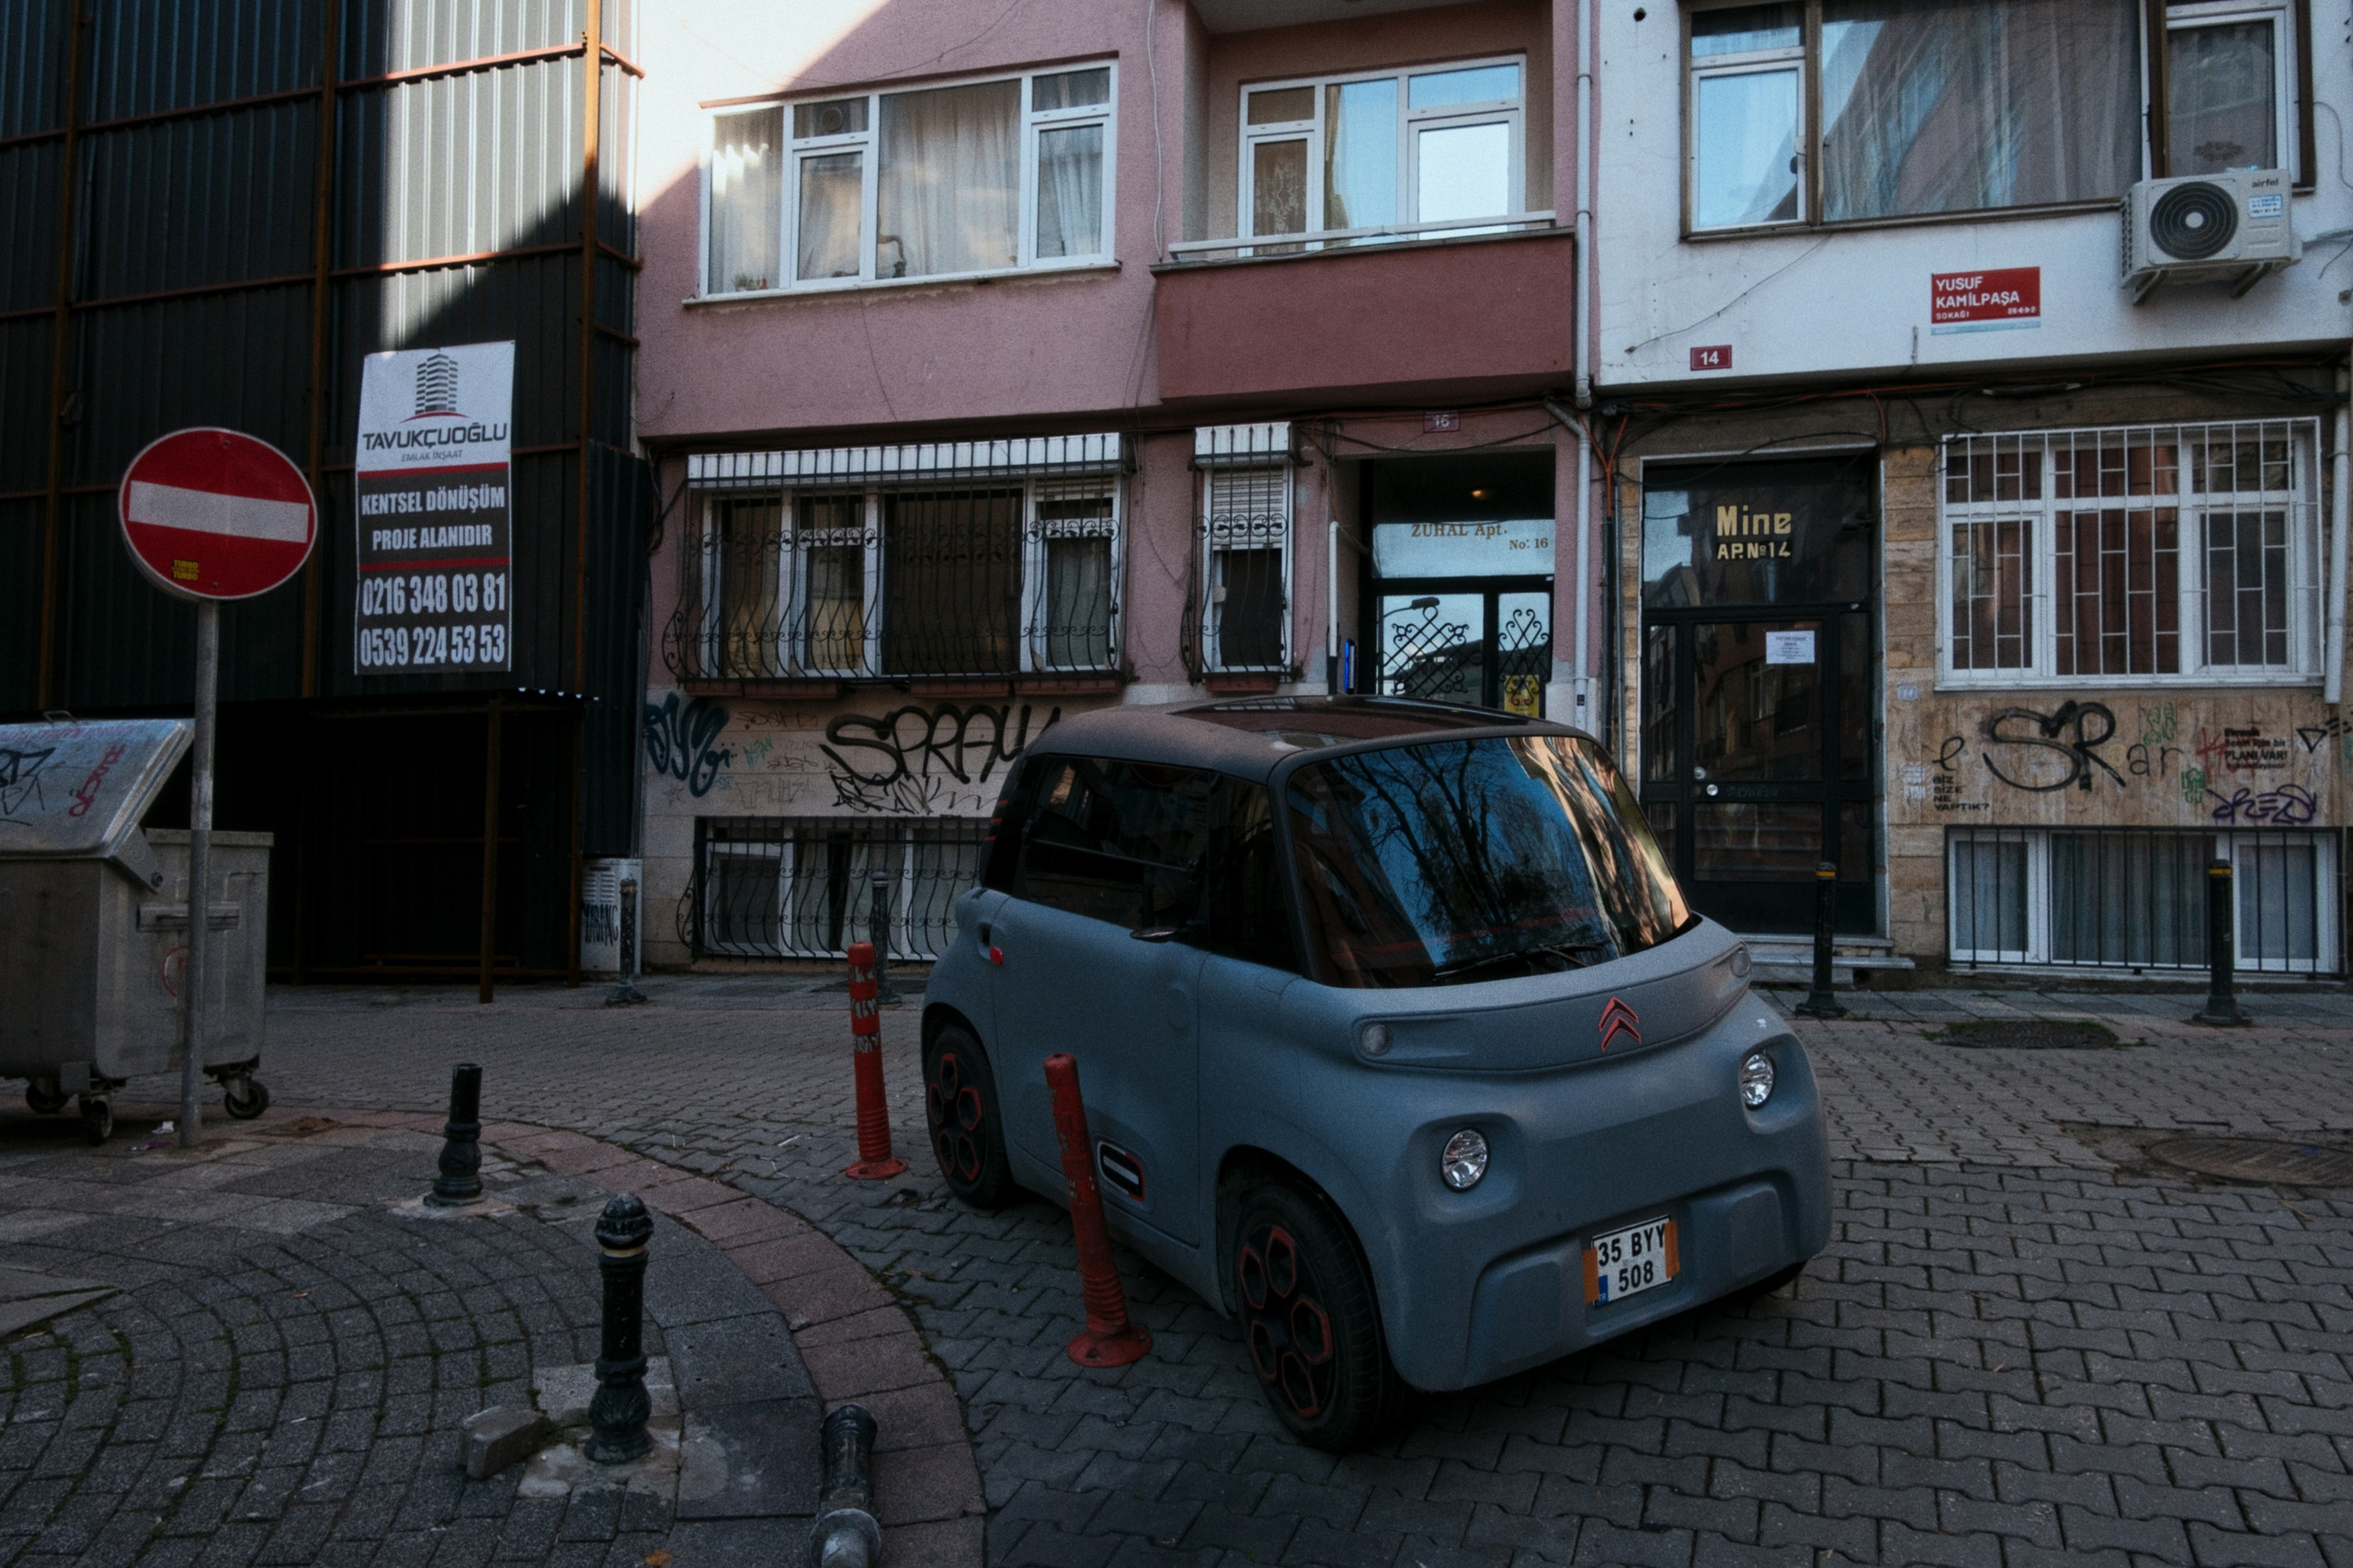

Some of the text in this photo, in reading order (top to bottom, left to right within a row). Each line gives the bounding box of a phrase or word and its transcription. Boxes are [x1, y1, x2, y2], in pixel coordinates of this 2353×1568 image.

[2252, 178, 2279, 188] airfel
[1936, 276, 1983, 291] YUSUF
[1936, 291, 2020, 309] KAMİLPAŞA
[1936, 311, 1970, 321] SOKAĞI
[1699, 351, 1720, 365] 14
[1434, 415, 1449, 427] 16
[362, 422, 507, 450] TAVUKÇUOĞLU
[402, 449, 462, 462] EMLAK İNŞAAT
[361, 483, 506, 516] KENTSEL DÖNÜŞÜM
[1717, 505, 1791, 537] Mine
[372, 524, 493, 551] PROJE ALANIDIR
[1411, 523, 1468, 538] ZUHAL
[1534, 537, 1549, 549] 16
[362, 573, 506, 616] 0216 348 03 81
[360, 623, 506, 666] 0539 224 53 53
[2224, 750, 2258, 760] PLANI
[1934, 802, 1989, 811] YAPTIK?
[1598, 1223, 1665, 1267] 35 BYY
[1619, 1260, 1654, 1292] 508
